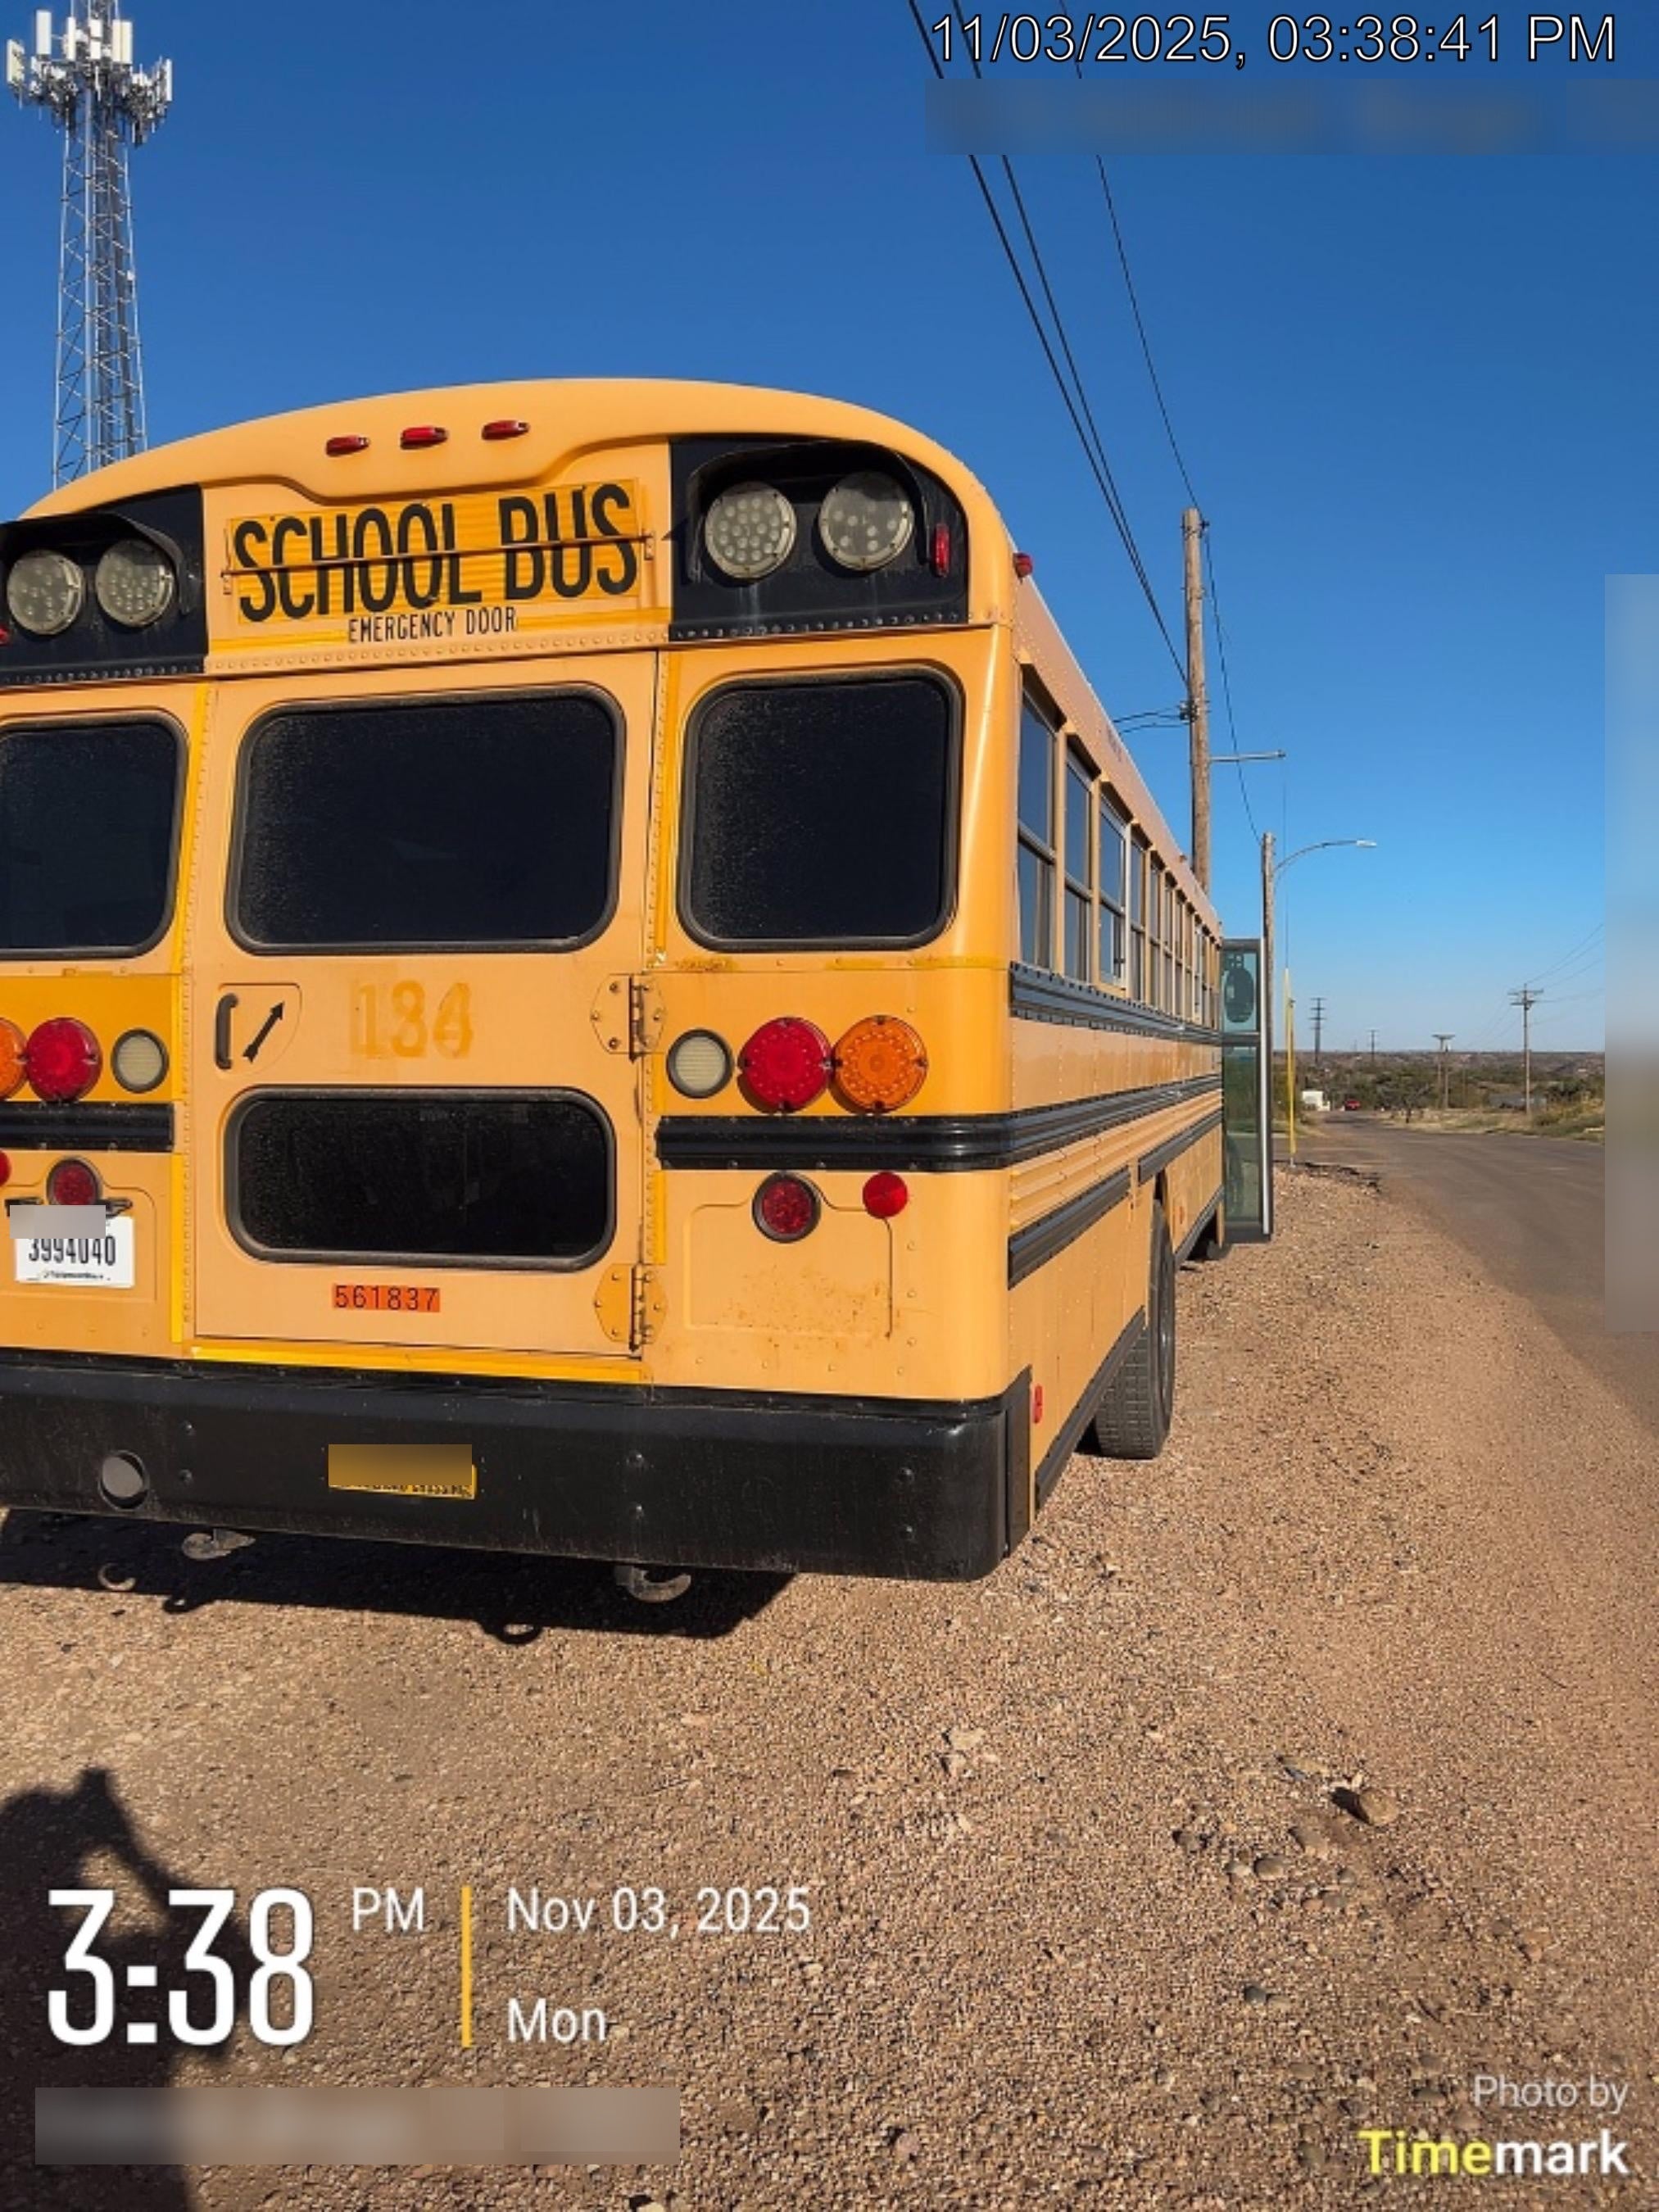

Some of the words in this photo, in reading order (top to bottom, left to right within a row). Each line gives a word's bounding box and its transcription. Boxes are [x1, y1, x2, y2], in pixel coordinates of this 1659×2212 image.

[233, 503, 482, 623] SCHOOL
[499, 483, 637, 601] BUS
[348, 610, 456, 644] EMERGENCY
[465, 607, 518, 633] DOOR
[334, 1285, 438, 1312] 561837
